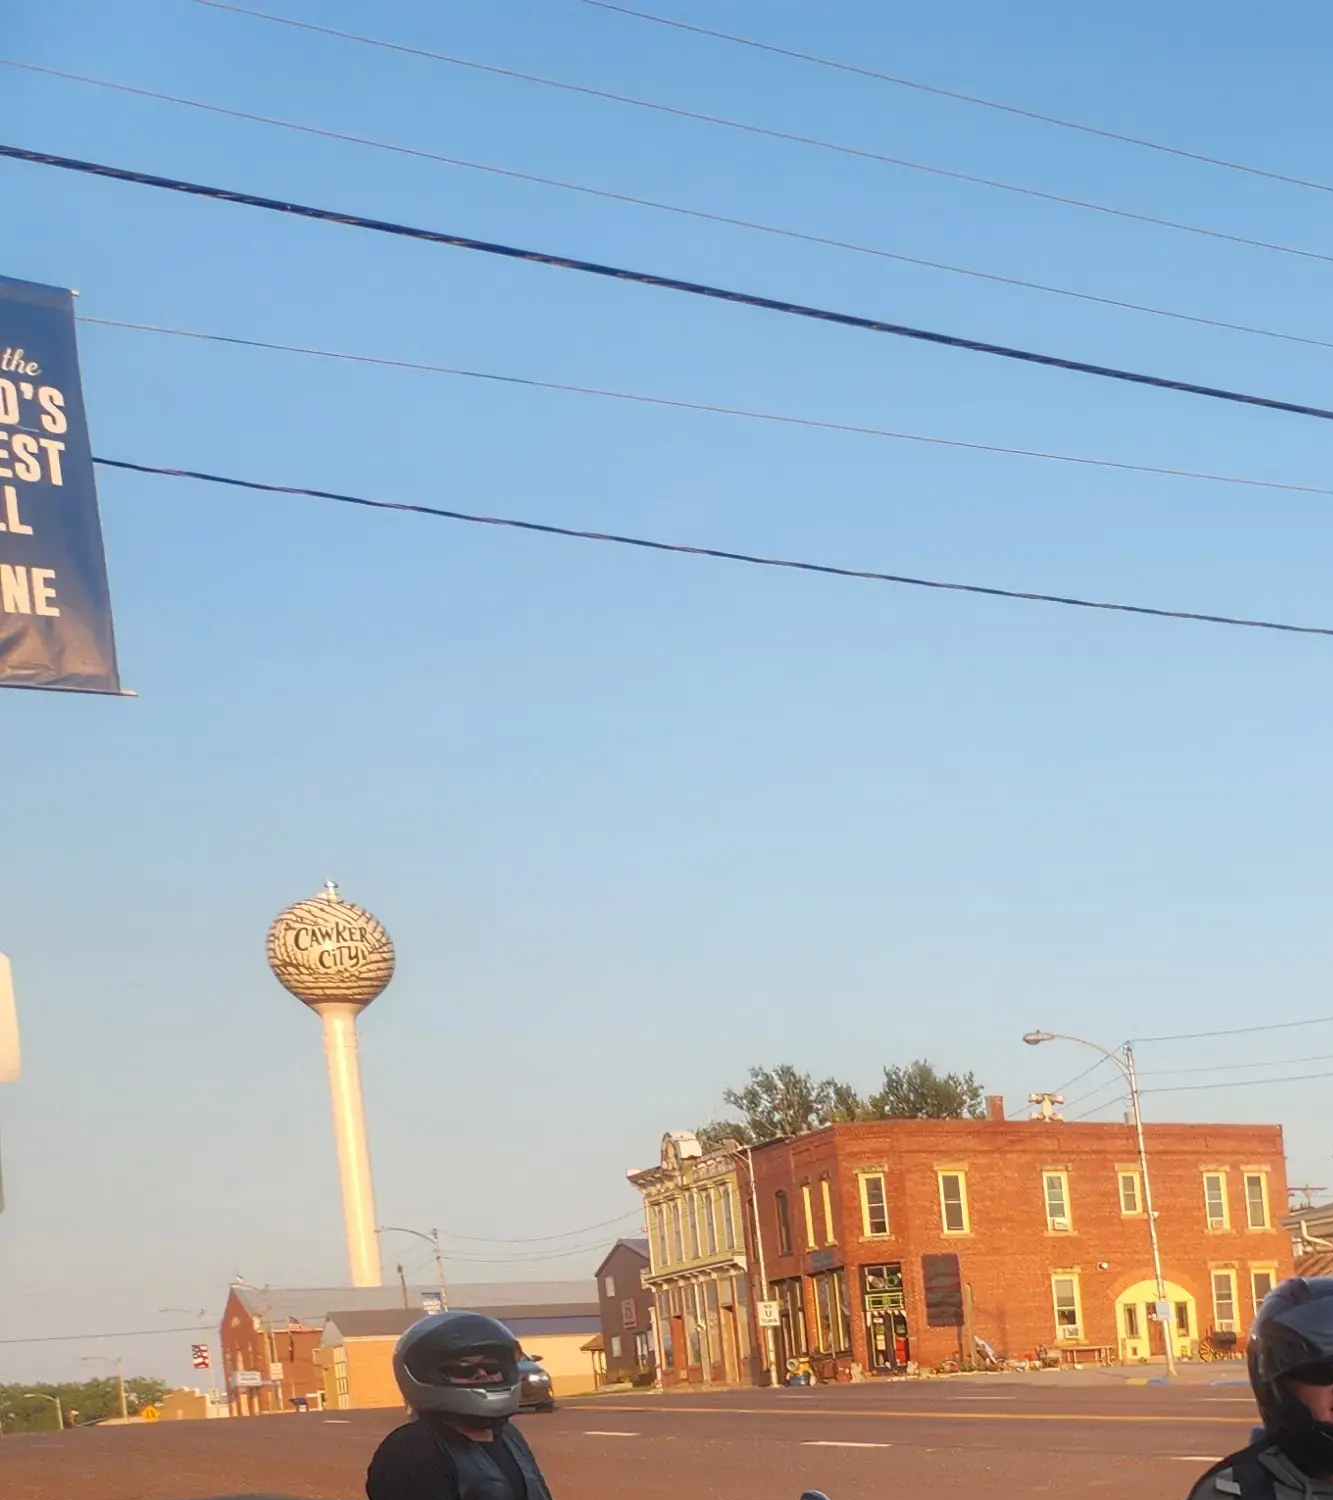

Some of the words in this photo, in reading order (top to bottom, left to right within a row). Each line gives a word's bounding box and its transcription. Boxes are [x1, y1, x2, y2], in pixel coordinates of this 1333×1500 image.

[1, 346, 40, 377] the
[0, 564, 60, 618] NE
[293, 921, 371, 951] CAWKER
